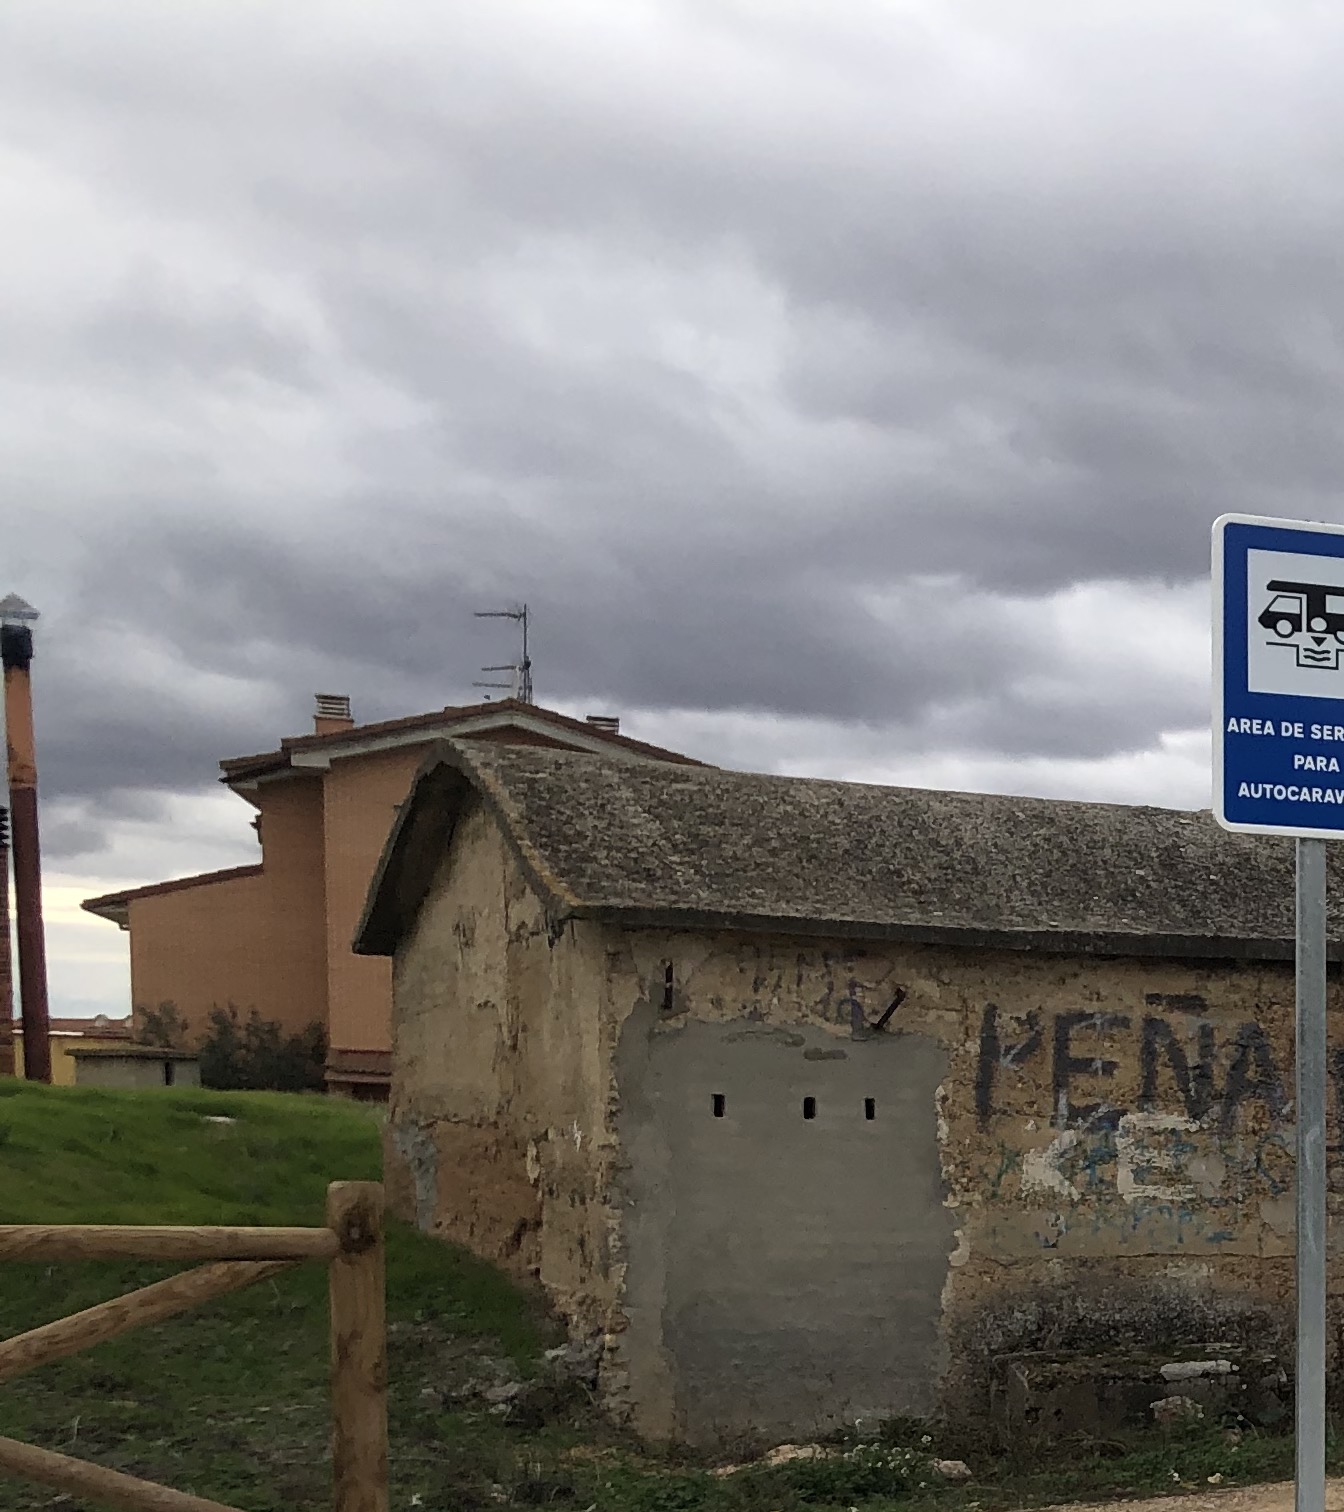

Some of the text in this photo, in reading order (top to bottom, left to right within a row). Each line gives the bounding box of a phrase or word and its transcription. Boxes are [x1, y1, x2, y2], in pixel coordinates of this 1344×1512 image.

[1227, 717, 1275, 736] AREA
[1281, 721, 1304, 738] DE
[1293, 754, 1340, 773] PARA
